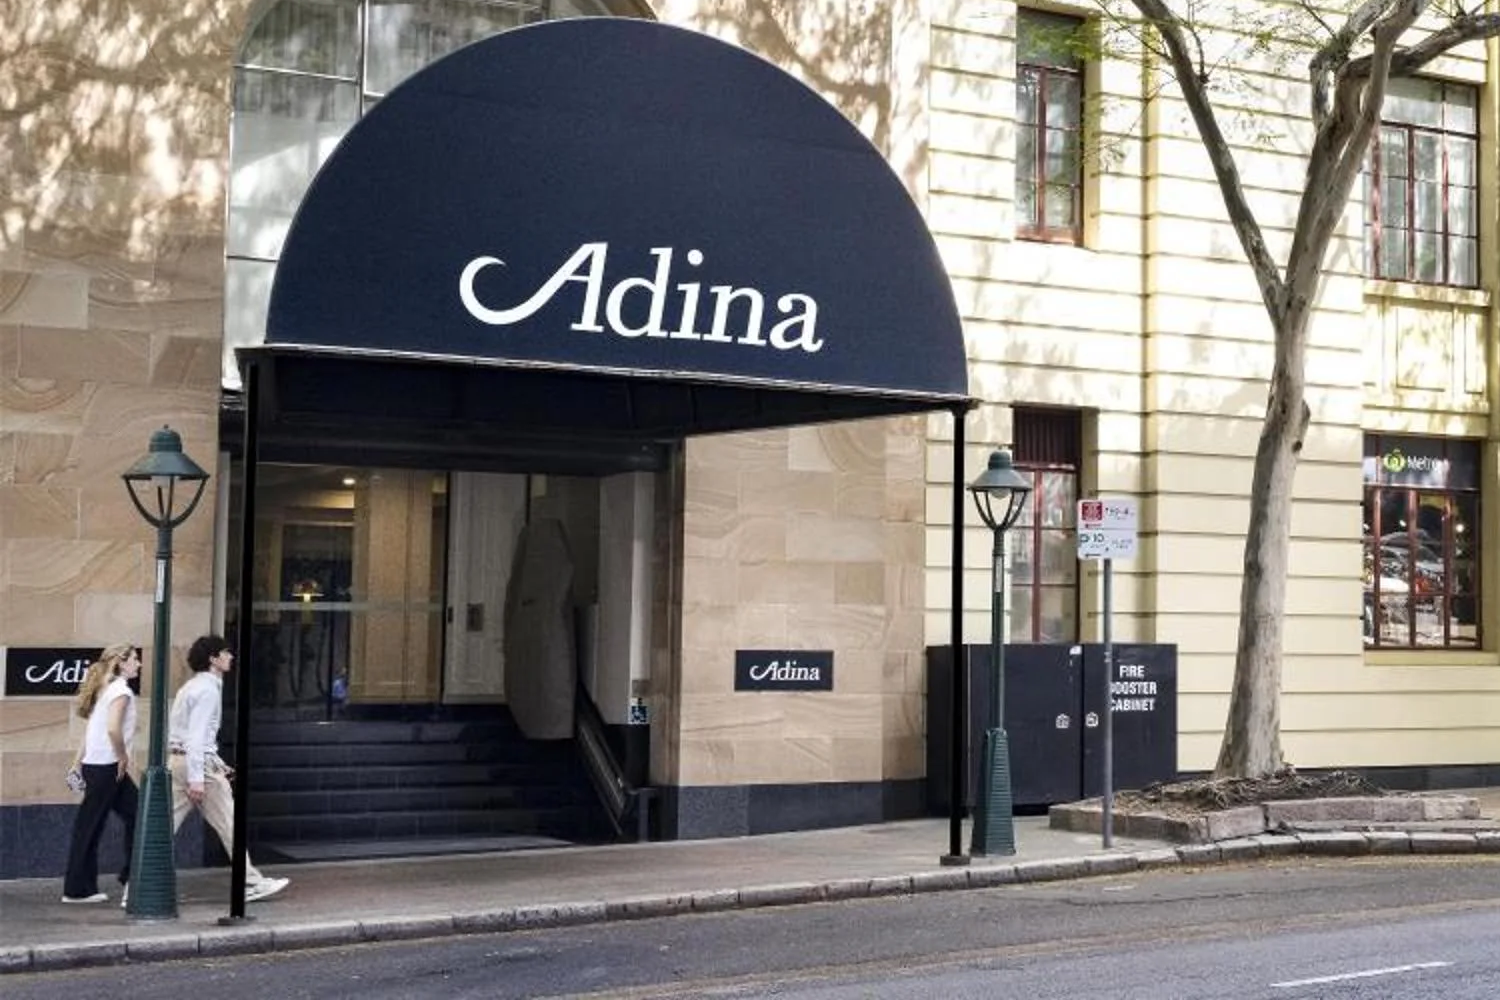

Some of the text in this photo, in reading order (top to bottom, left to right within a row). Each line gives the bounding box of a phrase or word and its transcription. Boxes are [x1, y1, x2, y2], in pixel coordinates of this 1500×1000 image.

[459, 242, 824, 352] Adina
[25, 659, 90, 683] Adi
[749, 660, 820, 681] Adina
[1120, 665, 1145, 678] FIRE
